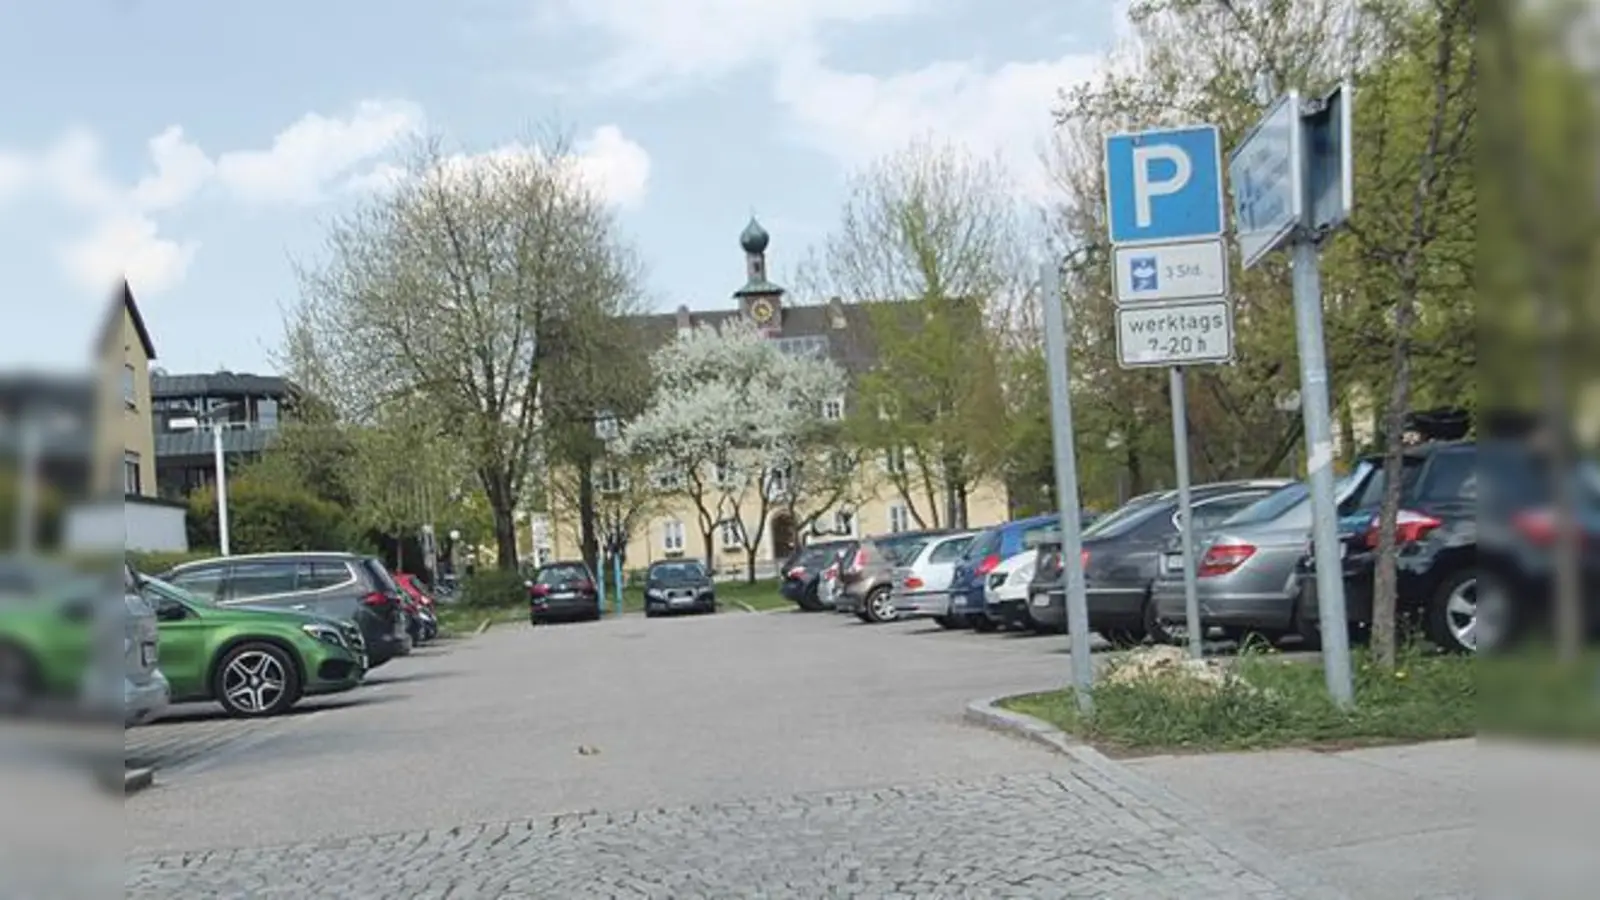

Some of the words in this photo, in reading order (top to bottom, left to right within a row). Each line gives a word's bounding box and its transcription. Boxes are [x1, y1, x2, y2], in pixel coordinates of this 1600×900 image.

[1132, 144, 1192, 228] P
[1128, 314, 1223, 333] werktags
[1197, 337, 1207, 351] h
